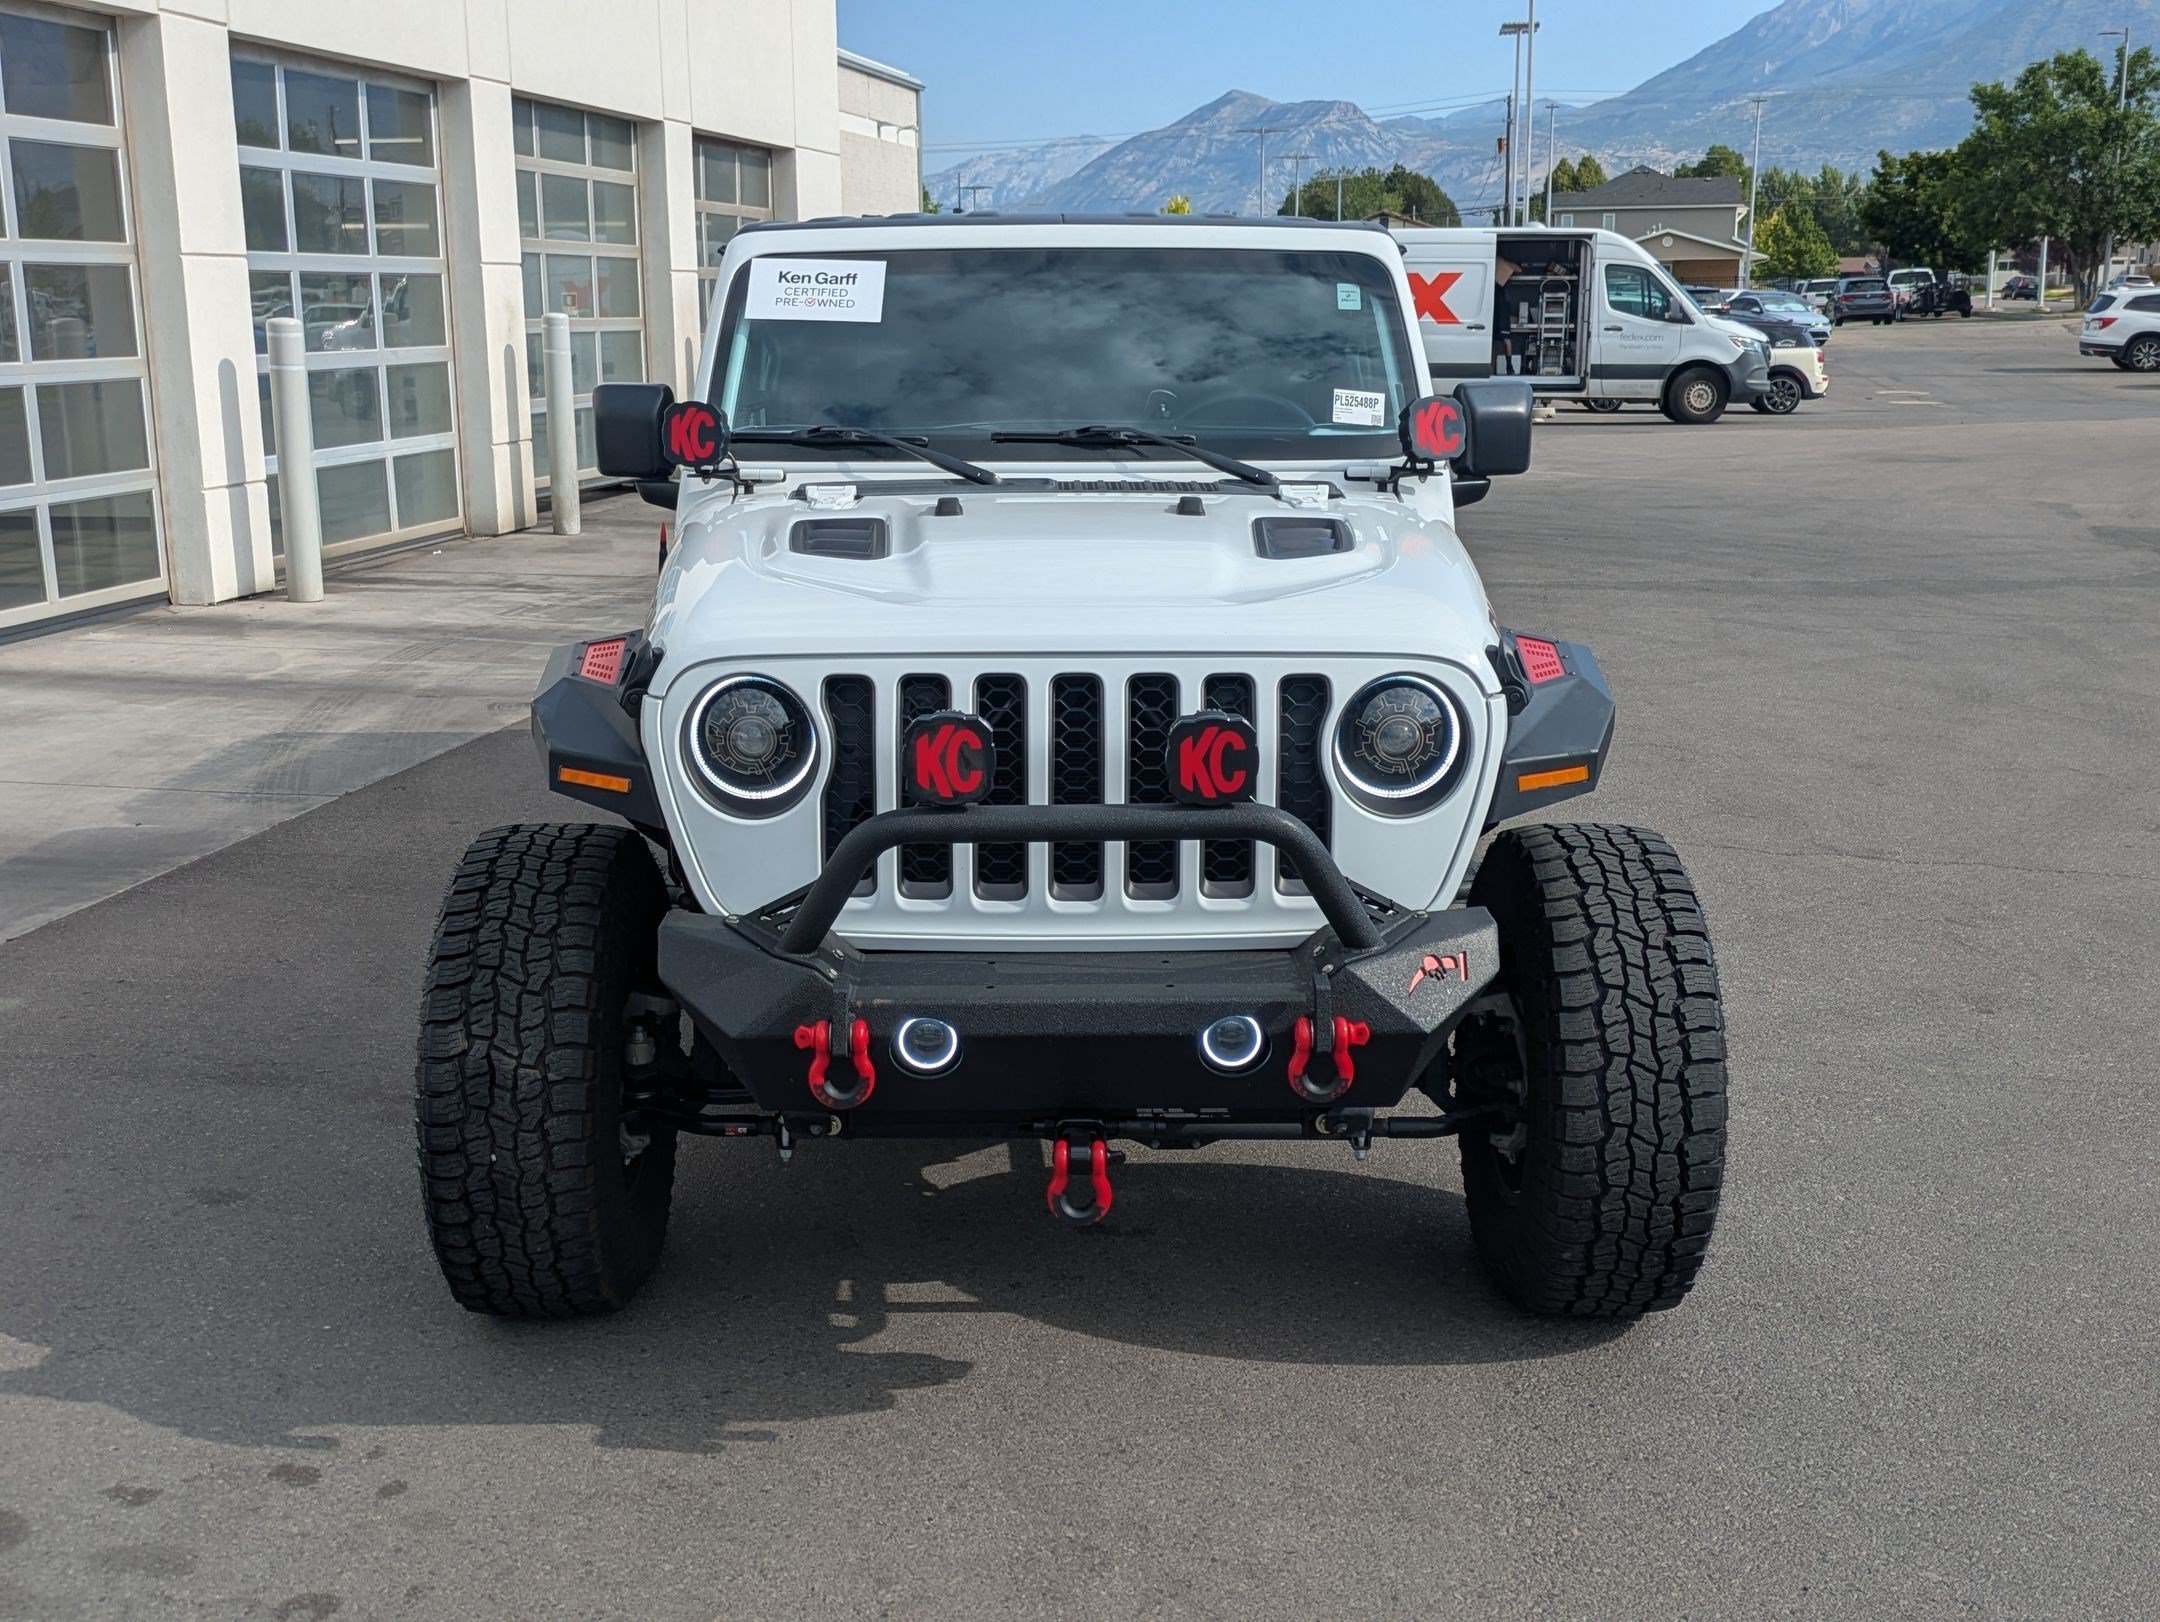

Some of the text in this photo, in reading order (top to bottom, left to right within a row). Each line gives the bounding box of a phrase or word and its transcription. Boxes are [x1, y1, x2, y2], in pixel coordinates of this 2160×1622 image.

[778, 270, 858, 286] Ken Garff
[784, 287, 849, 298] CERTIFIED
[775, 297, 856, 309] PRE-OWNED
[1334, 394, 1379, 409] PL525488P
[670, 407, 715, 461] KC
[1415, 402, 1461, 456] KC
[916, 724, 983, 798] KC
[1180, 726, 1247, 798] KC
